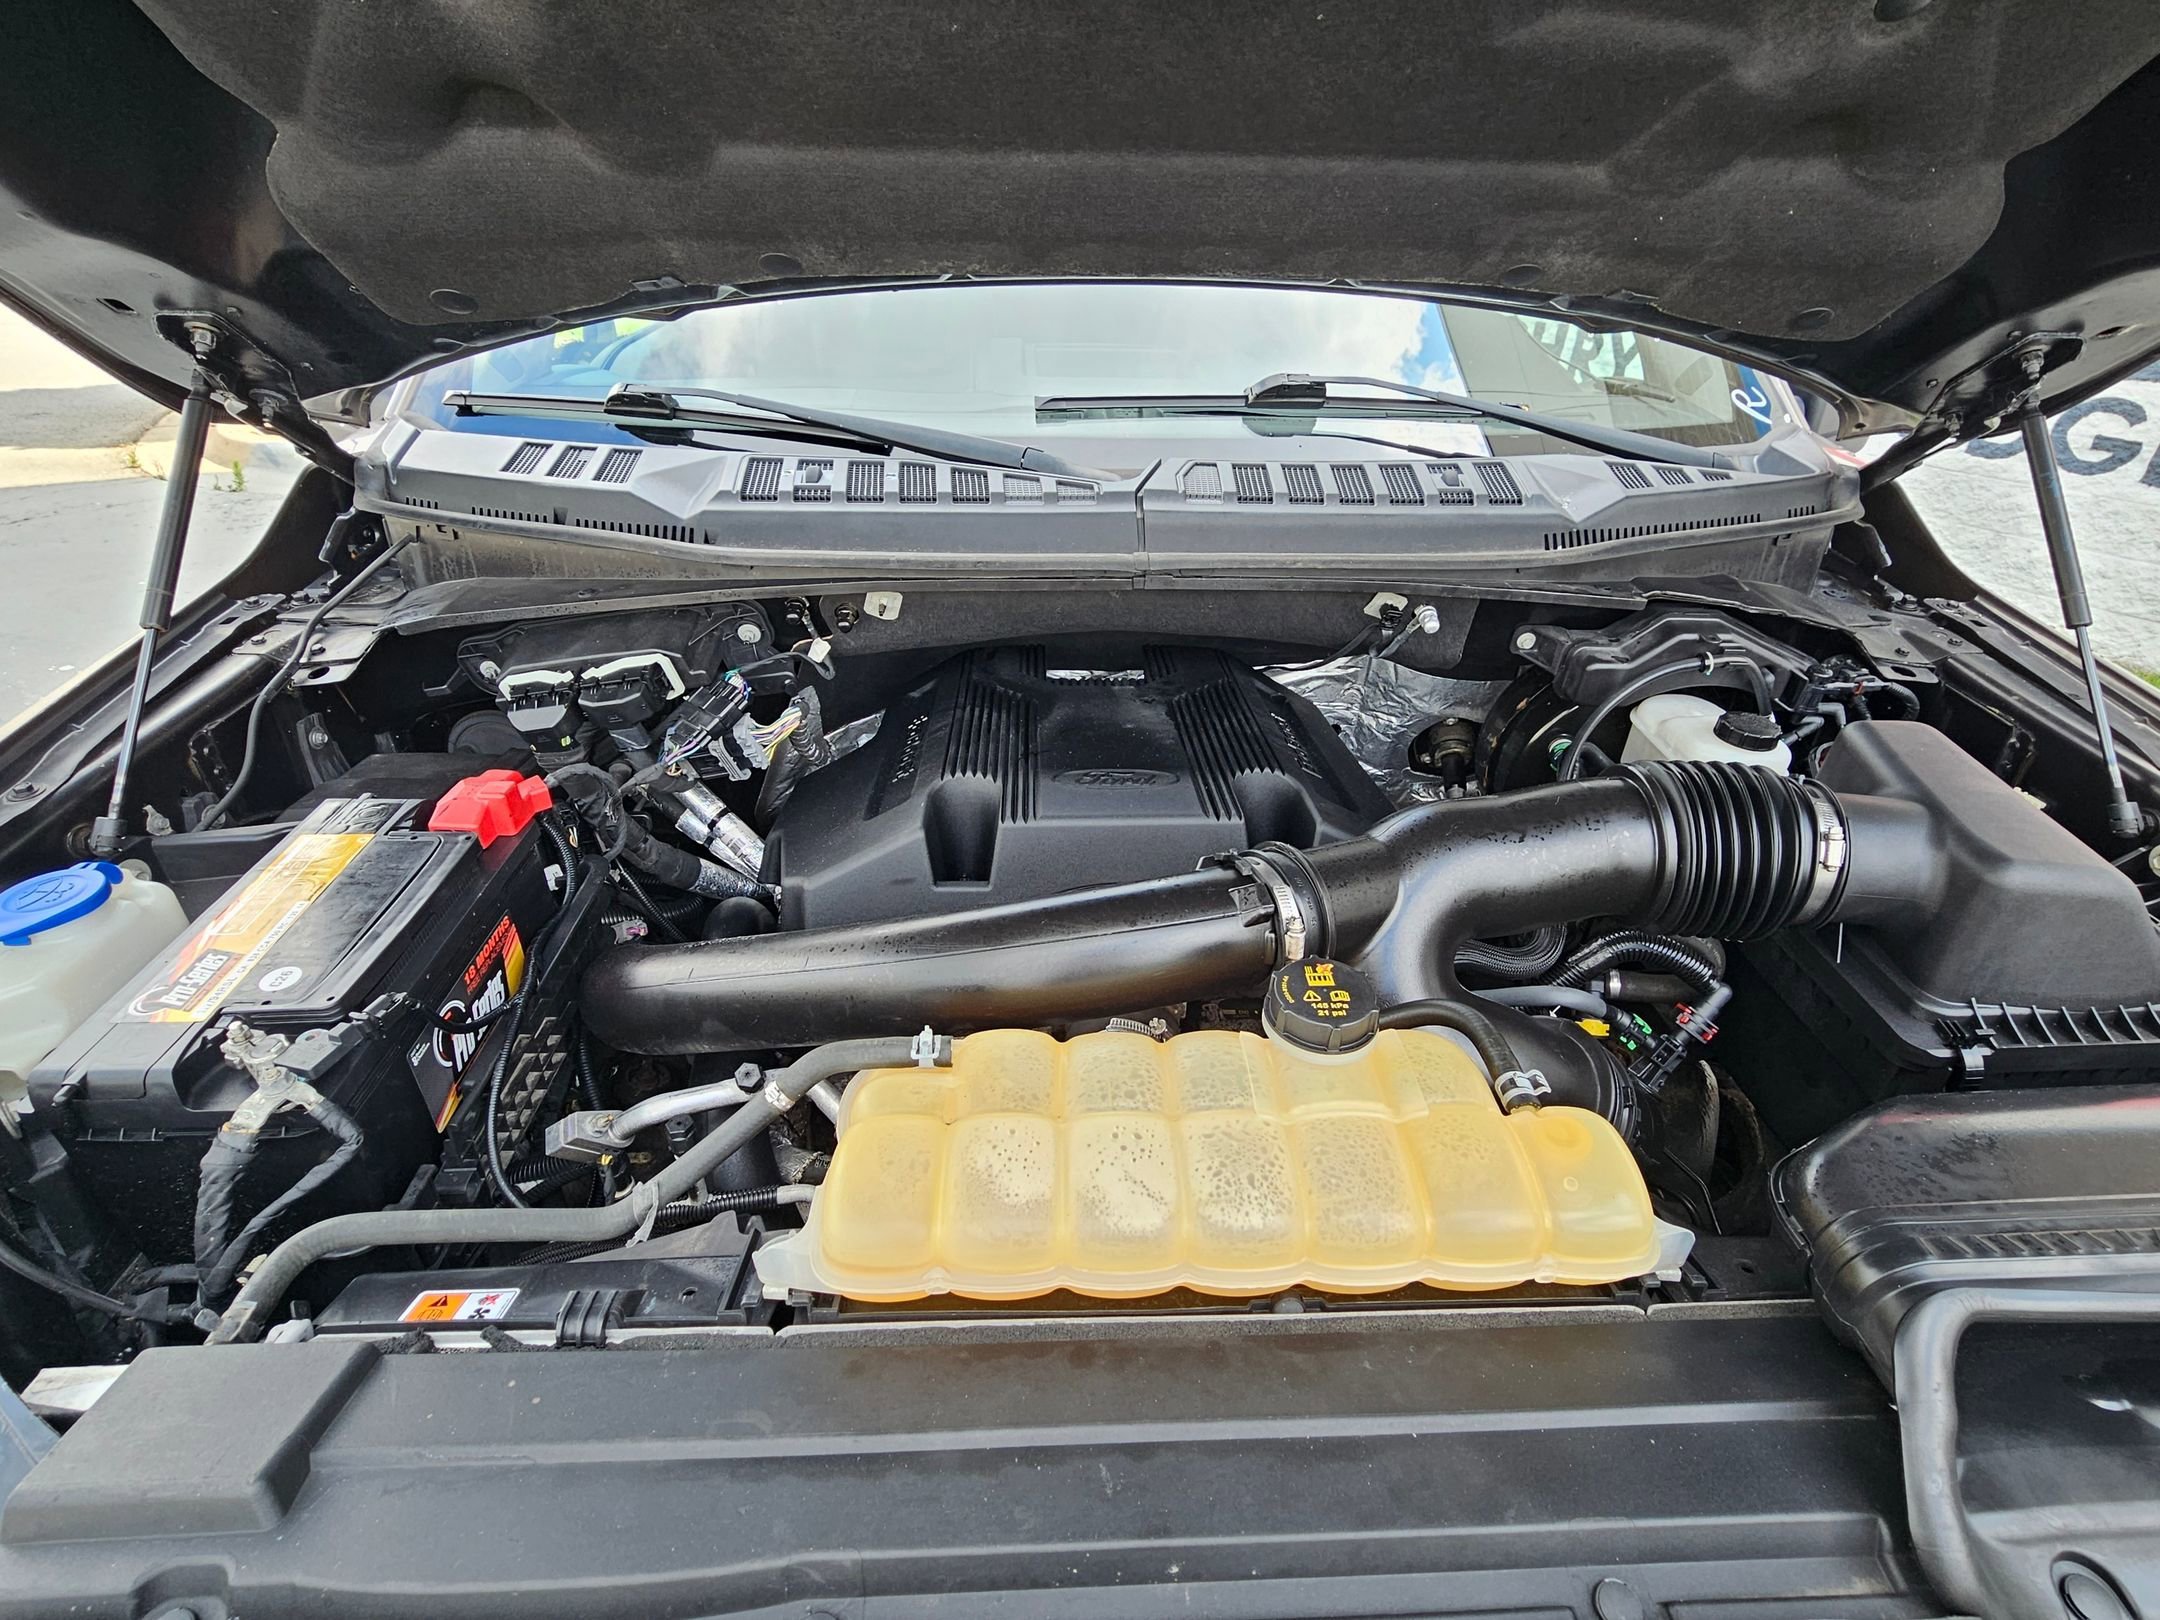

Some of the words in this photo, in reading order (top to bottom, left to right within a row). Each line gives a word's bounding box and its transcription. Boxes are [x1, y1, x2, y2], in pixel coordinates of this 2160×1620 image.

[1075, 770, 1157, 786] Ford
[476, 914, 511, 970] MONTHS
[1331, 1009, 1347, 1017] psi
